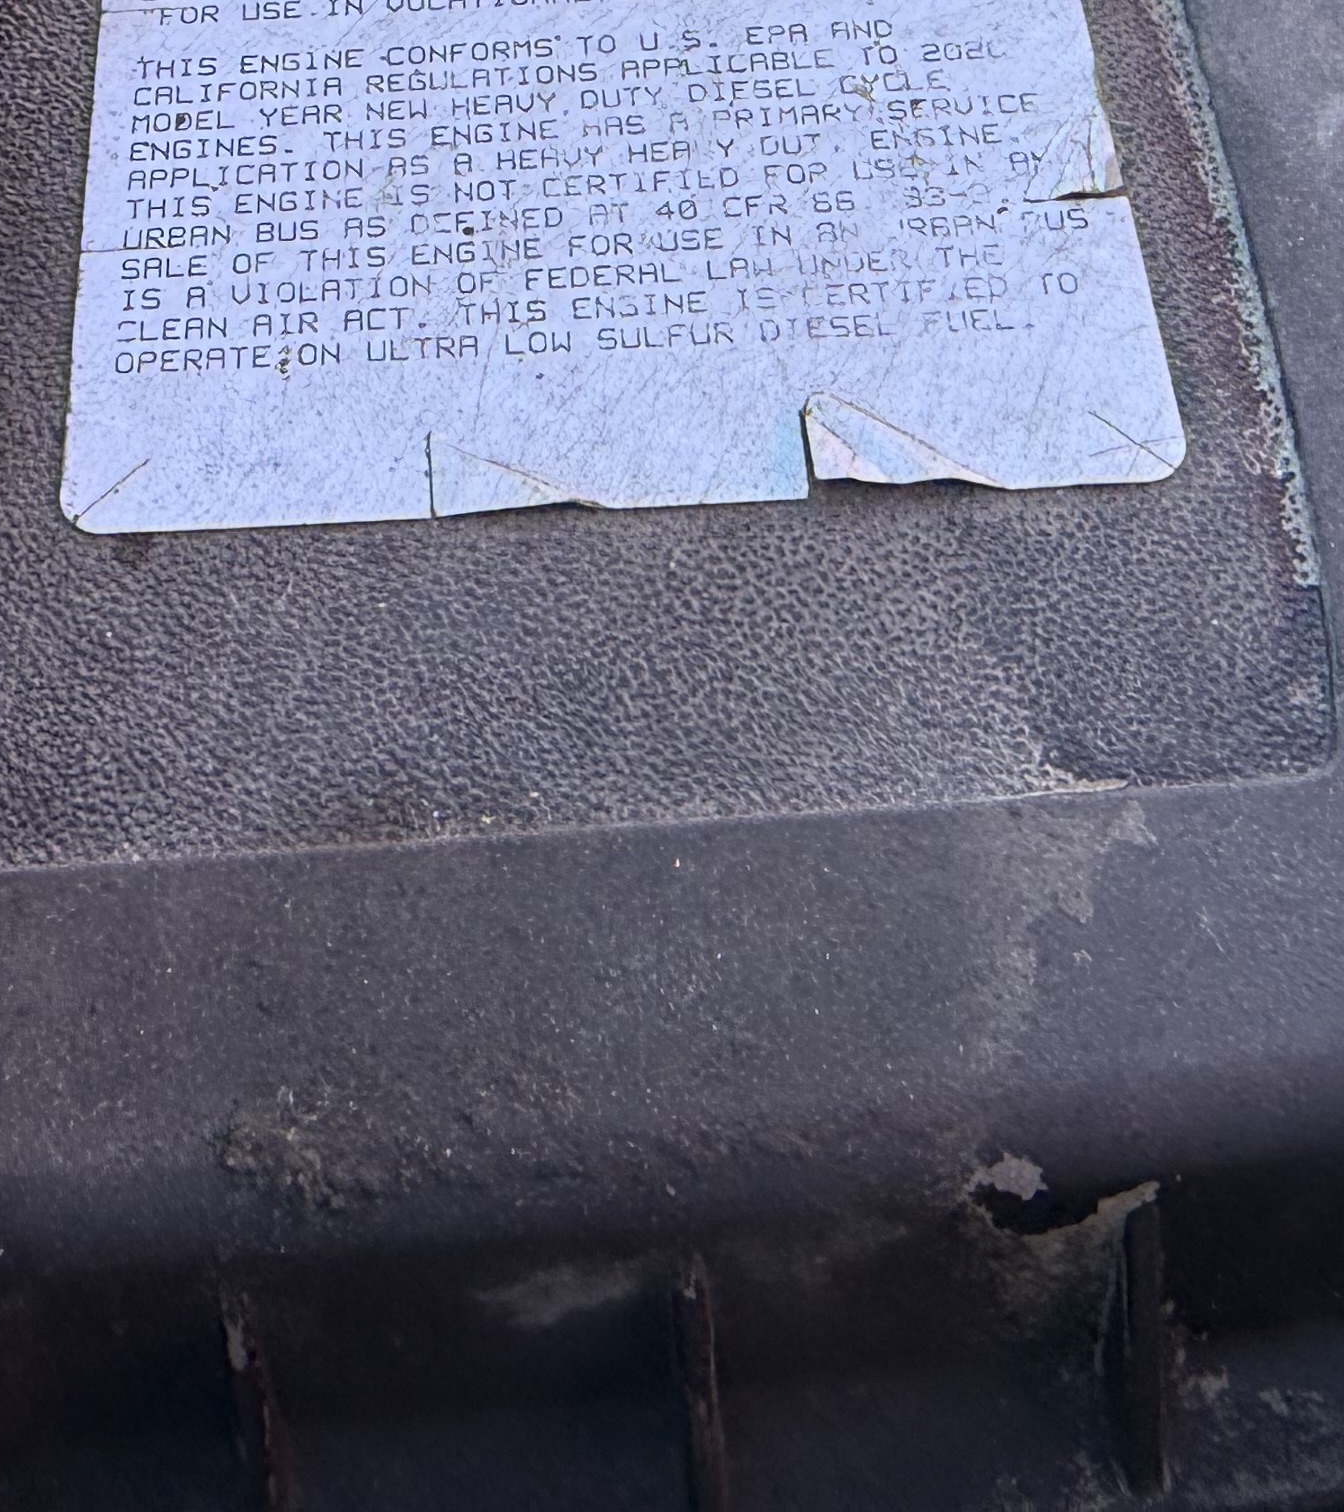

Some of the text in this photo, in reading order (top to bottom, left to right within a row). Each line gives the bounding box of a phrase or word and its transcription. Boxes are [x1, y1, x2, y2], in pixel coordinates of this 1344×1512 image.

[241, 0, 302, 21] USE
[133, 76, 343, 106] CALIFORNIA
[365, 61, 598, 94] REGULATIONS
[620, 48, 835, 80] APPLICABLE
[862, 45, 899, 67] TO
[136, 55, 218, 79] THIS
[239, 47, 365, 73] ENGINE
[385, 37, 554, 66] CONFORMS
[575, 34, 617, 55] TO
[744, 24, 809, 46] EPA
[830, 19, 893, 42] AND
[129, 93, 1039, 162] ENGINES. THIS ENGINE HAS A PRIMARY SERVICE
[131, 109, 236, 134] MODEL
[258, 103, 343, 127] YEAR
[365, 98, 428, 122] NEW
[451, 91, 557, 117] HEAVY
[580, 85, 662, 110] DUTY
[687, 76, 816, 104] DIESEL
[126, 195, 212, 219] THIS
[234, 187, 364, 213] ENGINE
[454, 179, 517, 202] NOT
[542, 167, 740, 197] CERTIFIED
[763, 162, 828, 186] FOR
[127, 157, 365, 191] APPLICATION
[387, 154, 429, 177] AS
[453, 151, 473, 173] A
[497, 144, 604, 171] HEAVY
[627, 137, 735, 164] HEAY
[122, 223, 232, 250] URBAN
[255, 219, 320, 243] BUS
[343, 215, 387, 238] AS
[588, 202, 628, 225] AT
[655, 198, 699, 221] 40
[722, 194, 789, 218] CFR
[120, 255, 208, 280] SALE
[232, 251, 274, 274] OF
[299, 245, 387, 271] THIS
[411, 237, 544, 265] ENGINE
[568, 232, 634, 256] FOR
[657, 227, 724, 252] USE
[752, 223, 793, 247] IN
[122, 288, 161, 311] IS
[186, 286, 206, 308] A
[231, 274, 432, 305] VIOLATION
[456, 271, 501, 294] OF
[524, 261, 682, 290] FEDERAL
[936, 244, 1004, 269] THE
[114, 345, 272, 374] OPERATE
[296, 342, 342, 365] ON
[366, 335, 480, 362] ULTRA
[504, 330, 573, 355] LOW
[596, 322, 734, 350] SULFUR
[758, 314, 896, 342] DIESEL
[116, 315, 228, 343] CLEAN
[252, 311, 319, 336] AIR
[343, 305, 427, 331] ACT.
[457, 299, 547, 326] THIS
[572, 291, 708, 320] ENGINE
